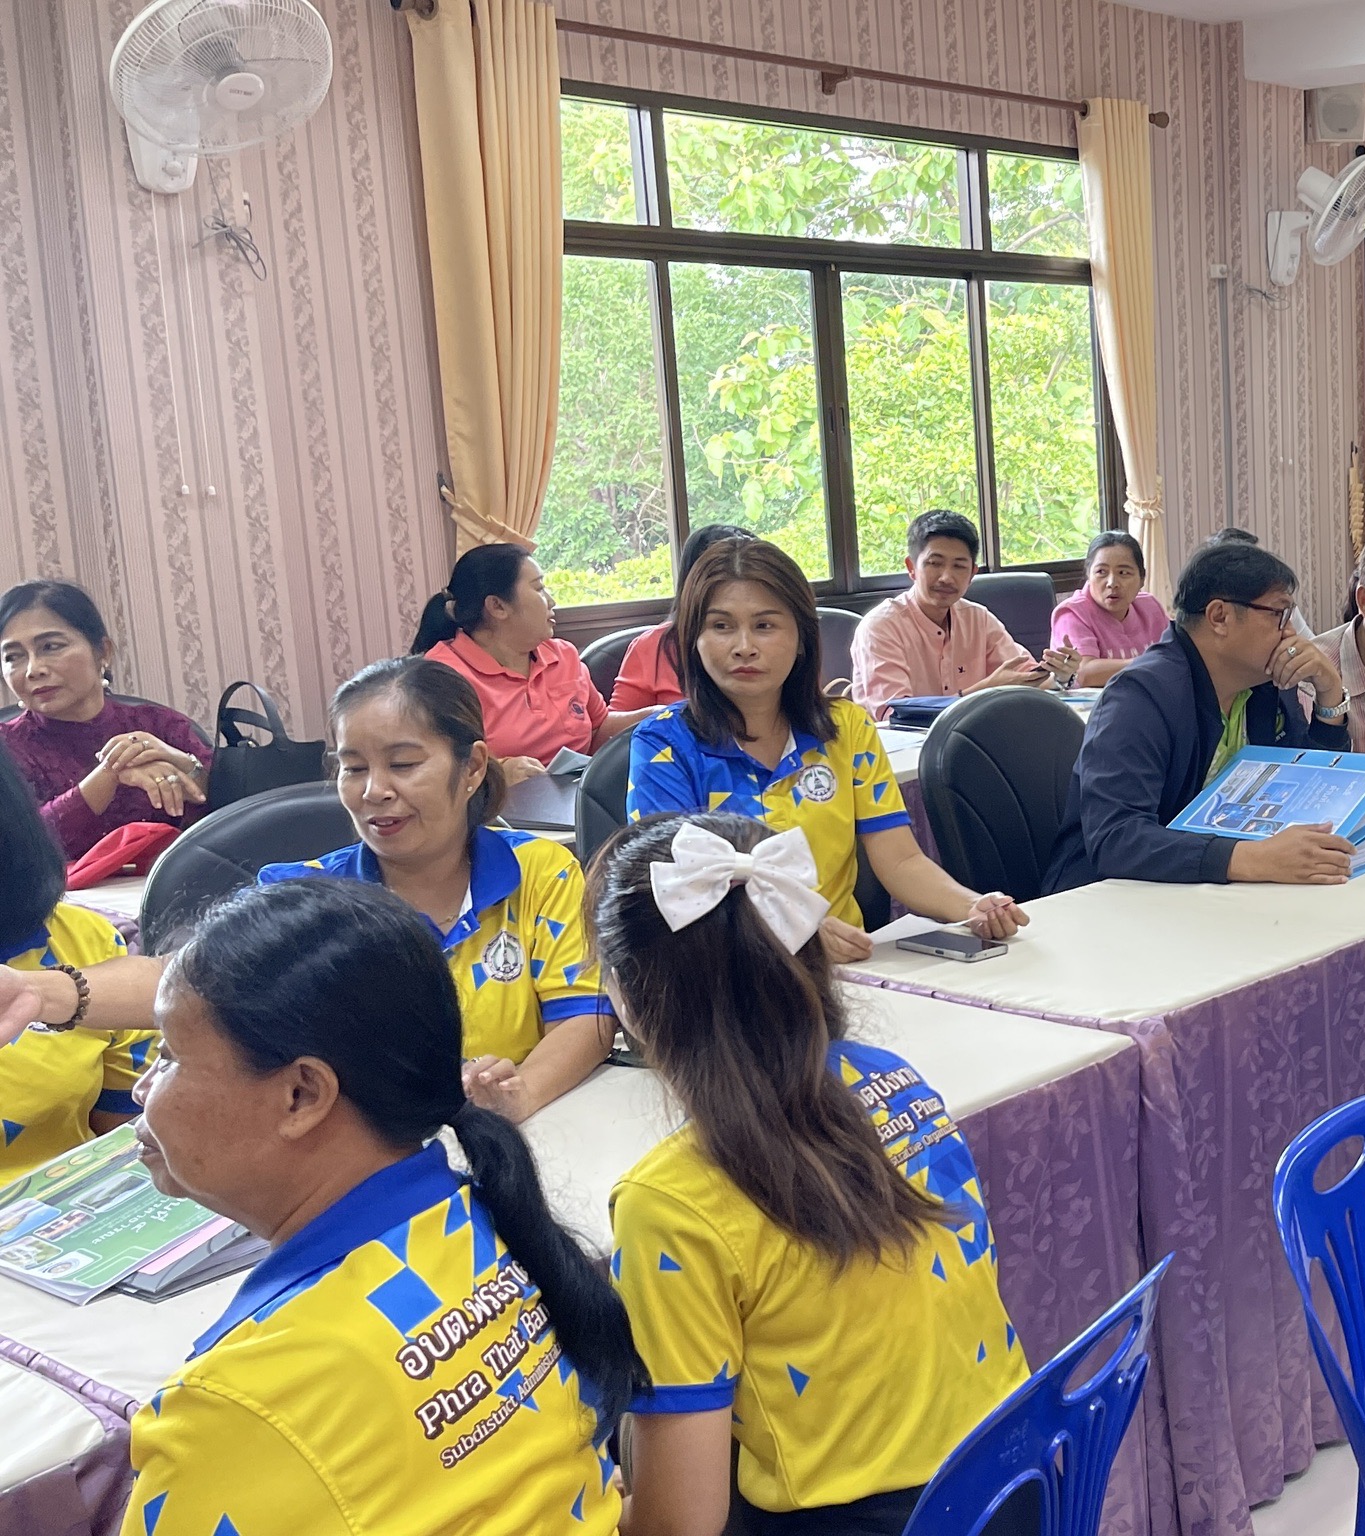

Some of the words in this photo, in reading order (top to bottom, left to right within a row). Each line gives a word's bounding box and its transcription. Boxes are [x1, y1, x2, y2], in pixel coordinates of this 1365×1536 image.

[418, 1370, 489, 1437] Phra
[482, 1327, 528, 1379] That
[441, 1394, 517, 1468] Subdistrict
